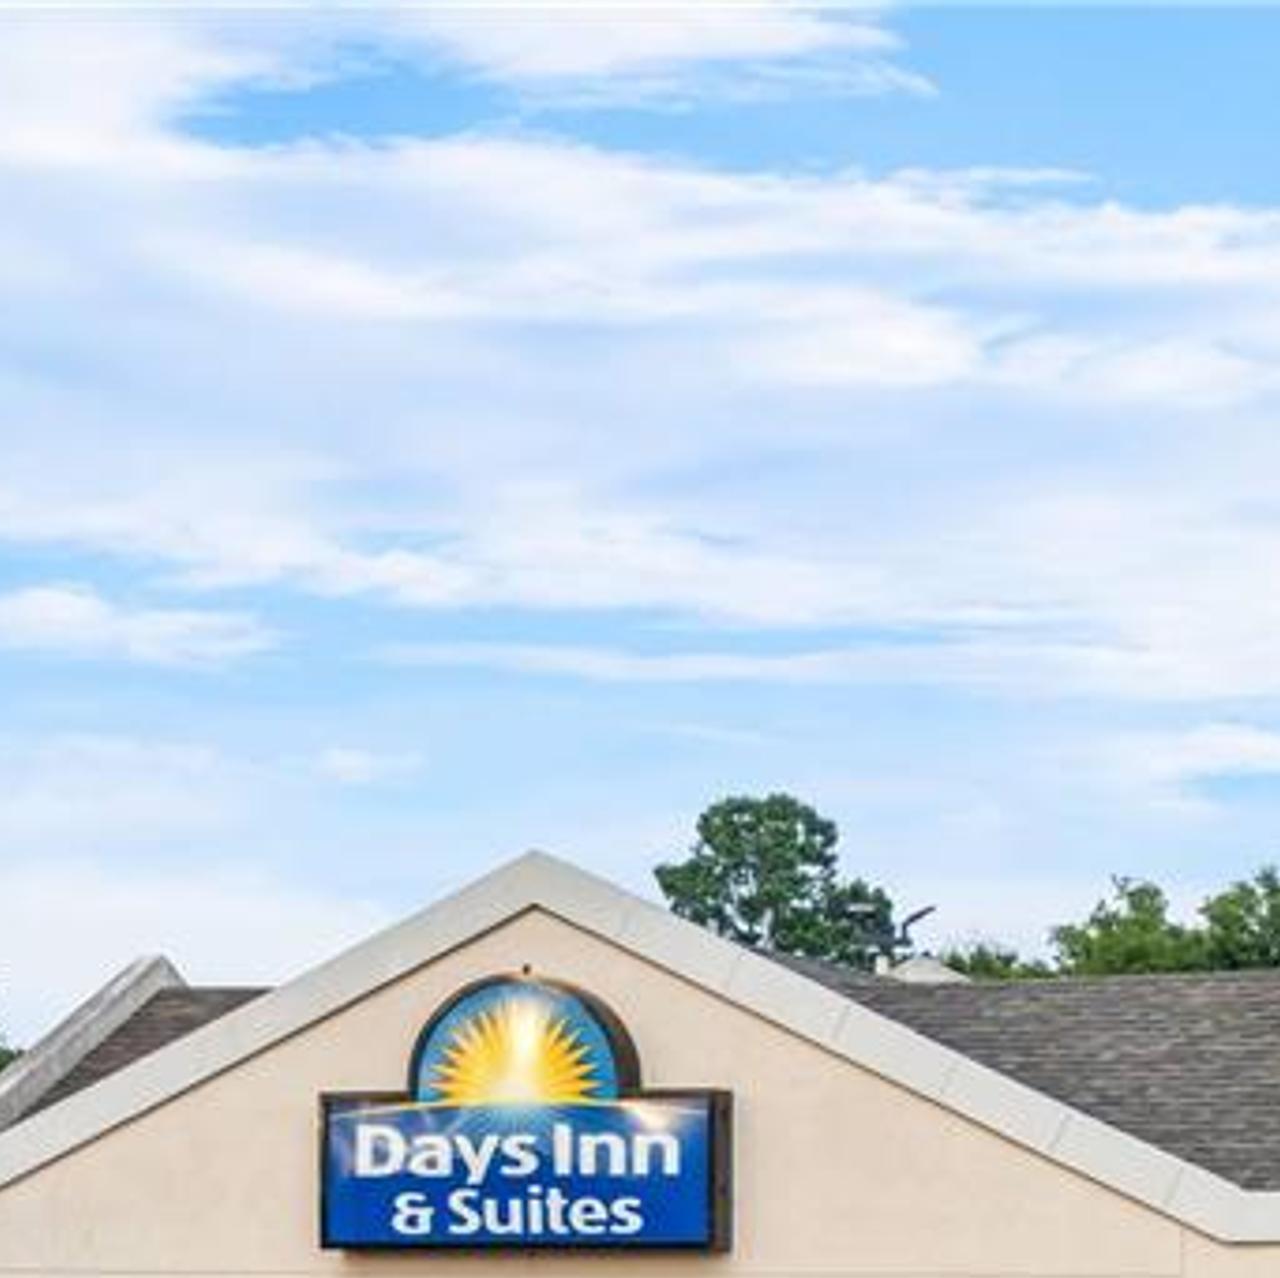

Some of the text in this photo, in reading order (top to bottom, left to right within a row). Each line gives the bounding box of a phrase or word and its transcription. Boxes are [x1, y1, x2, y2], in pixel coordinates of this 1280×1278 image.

[354, 1123, 682, 1185] Days Inn
[391, 1185, 644, 1236] & Suites
